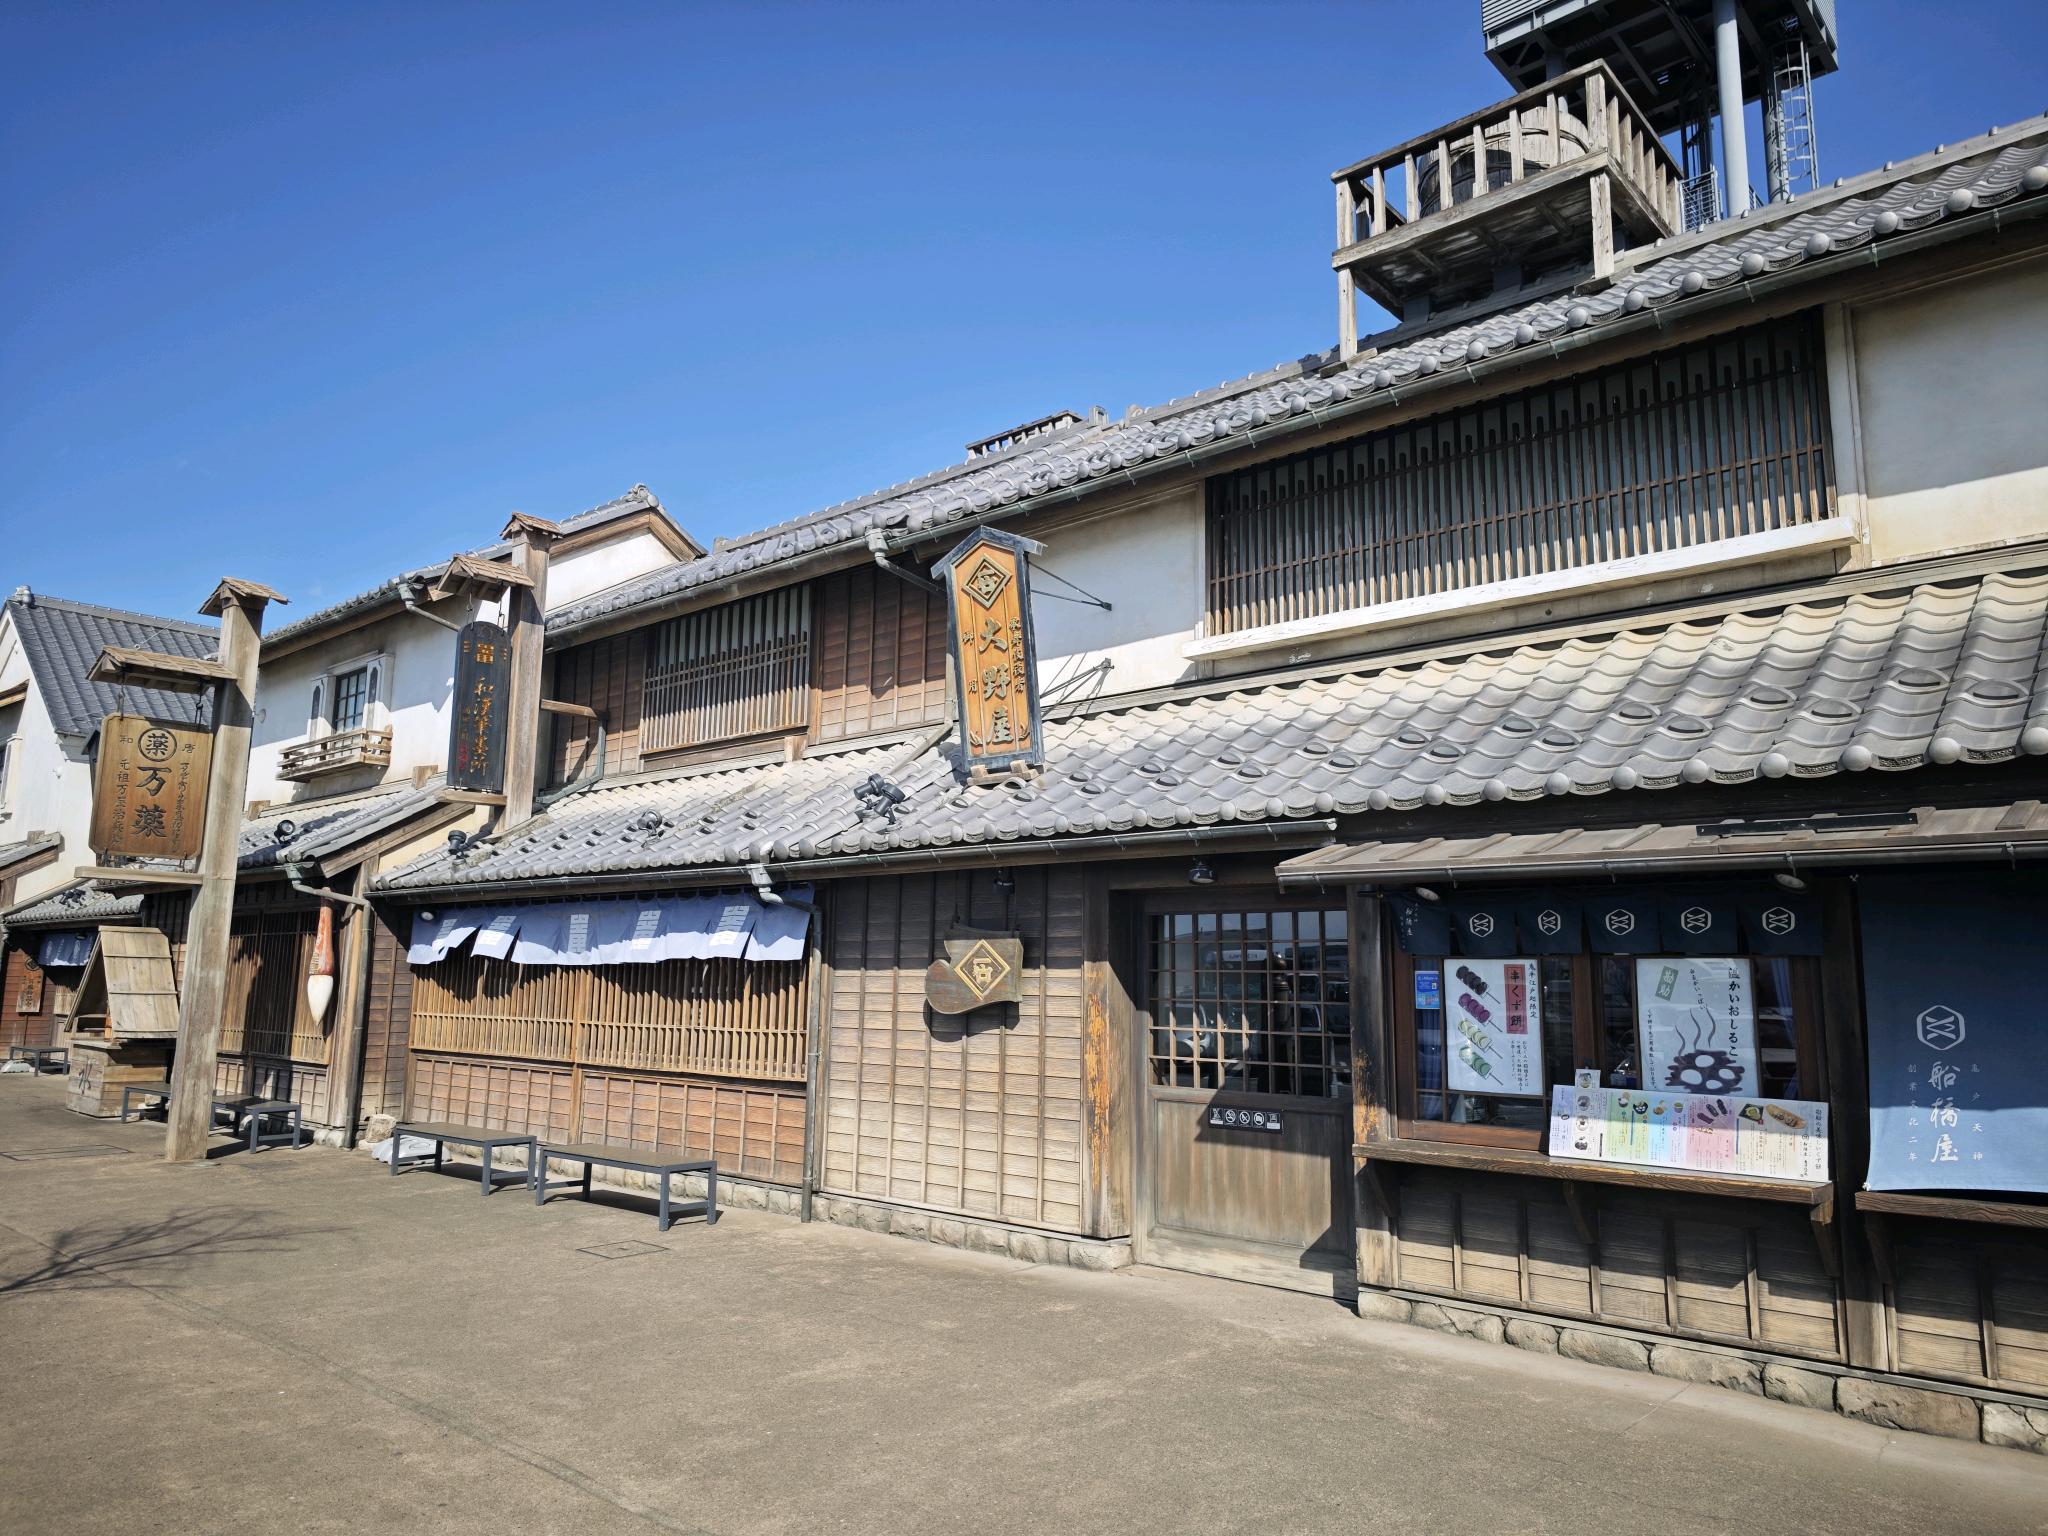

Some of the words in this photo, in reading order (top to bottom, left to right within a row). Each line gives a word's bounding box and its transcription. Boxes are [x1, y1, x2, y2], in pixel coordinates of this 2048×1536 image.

[978, 616, 1015, 746] 大野屋
[119, 734, 134, 744] 和
[131, 766, 172, 838] 万薬
[1510, 969, 1522, 1027] 串くず餅
[1728, 967, 1740, 1057] 温かいおしるこ
[1928, 1061, 1961, 1163] 船橋屋
[1971, 1063, 1984, 1161] 亀戸天神
